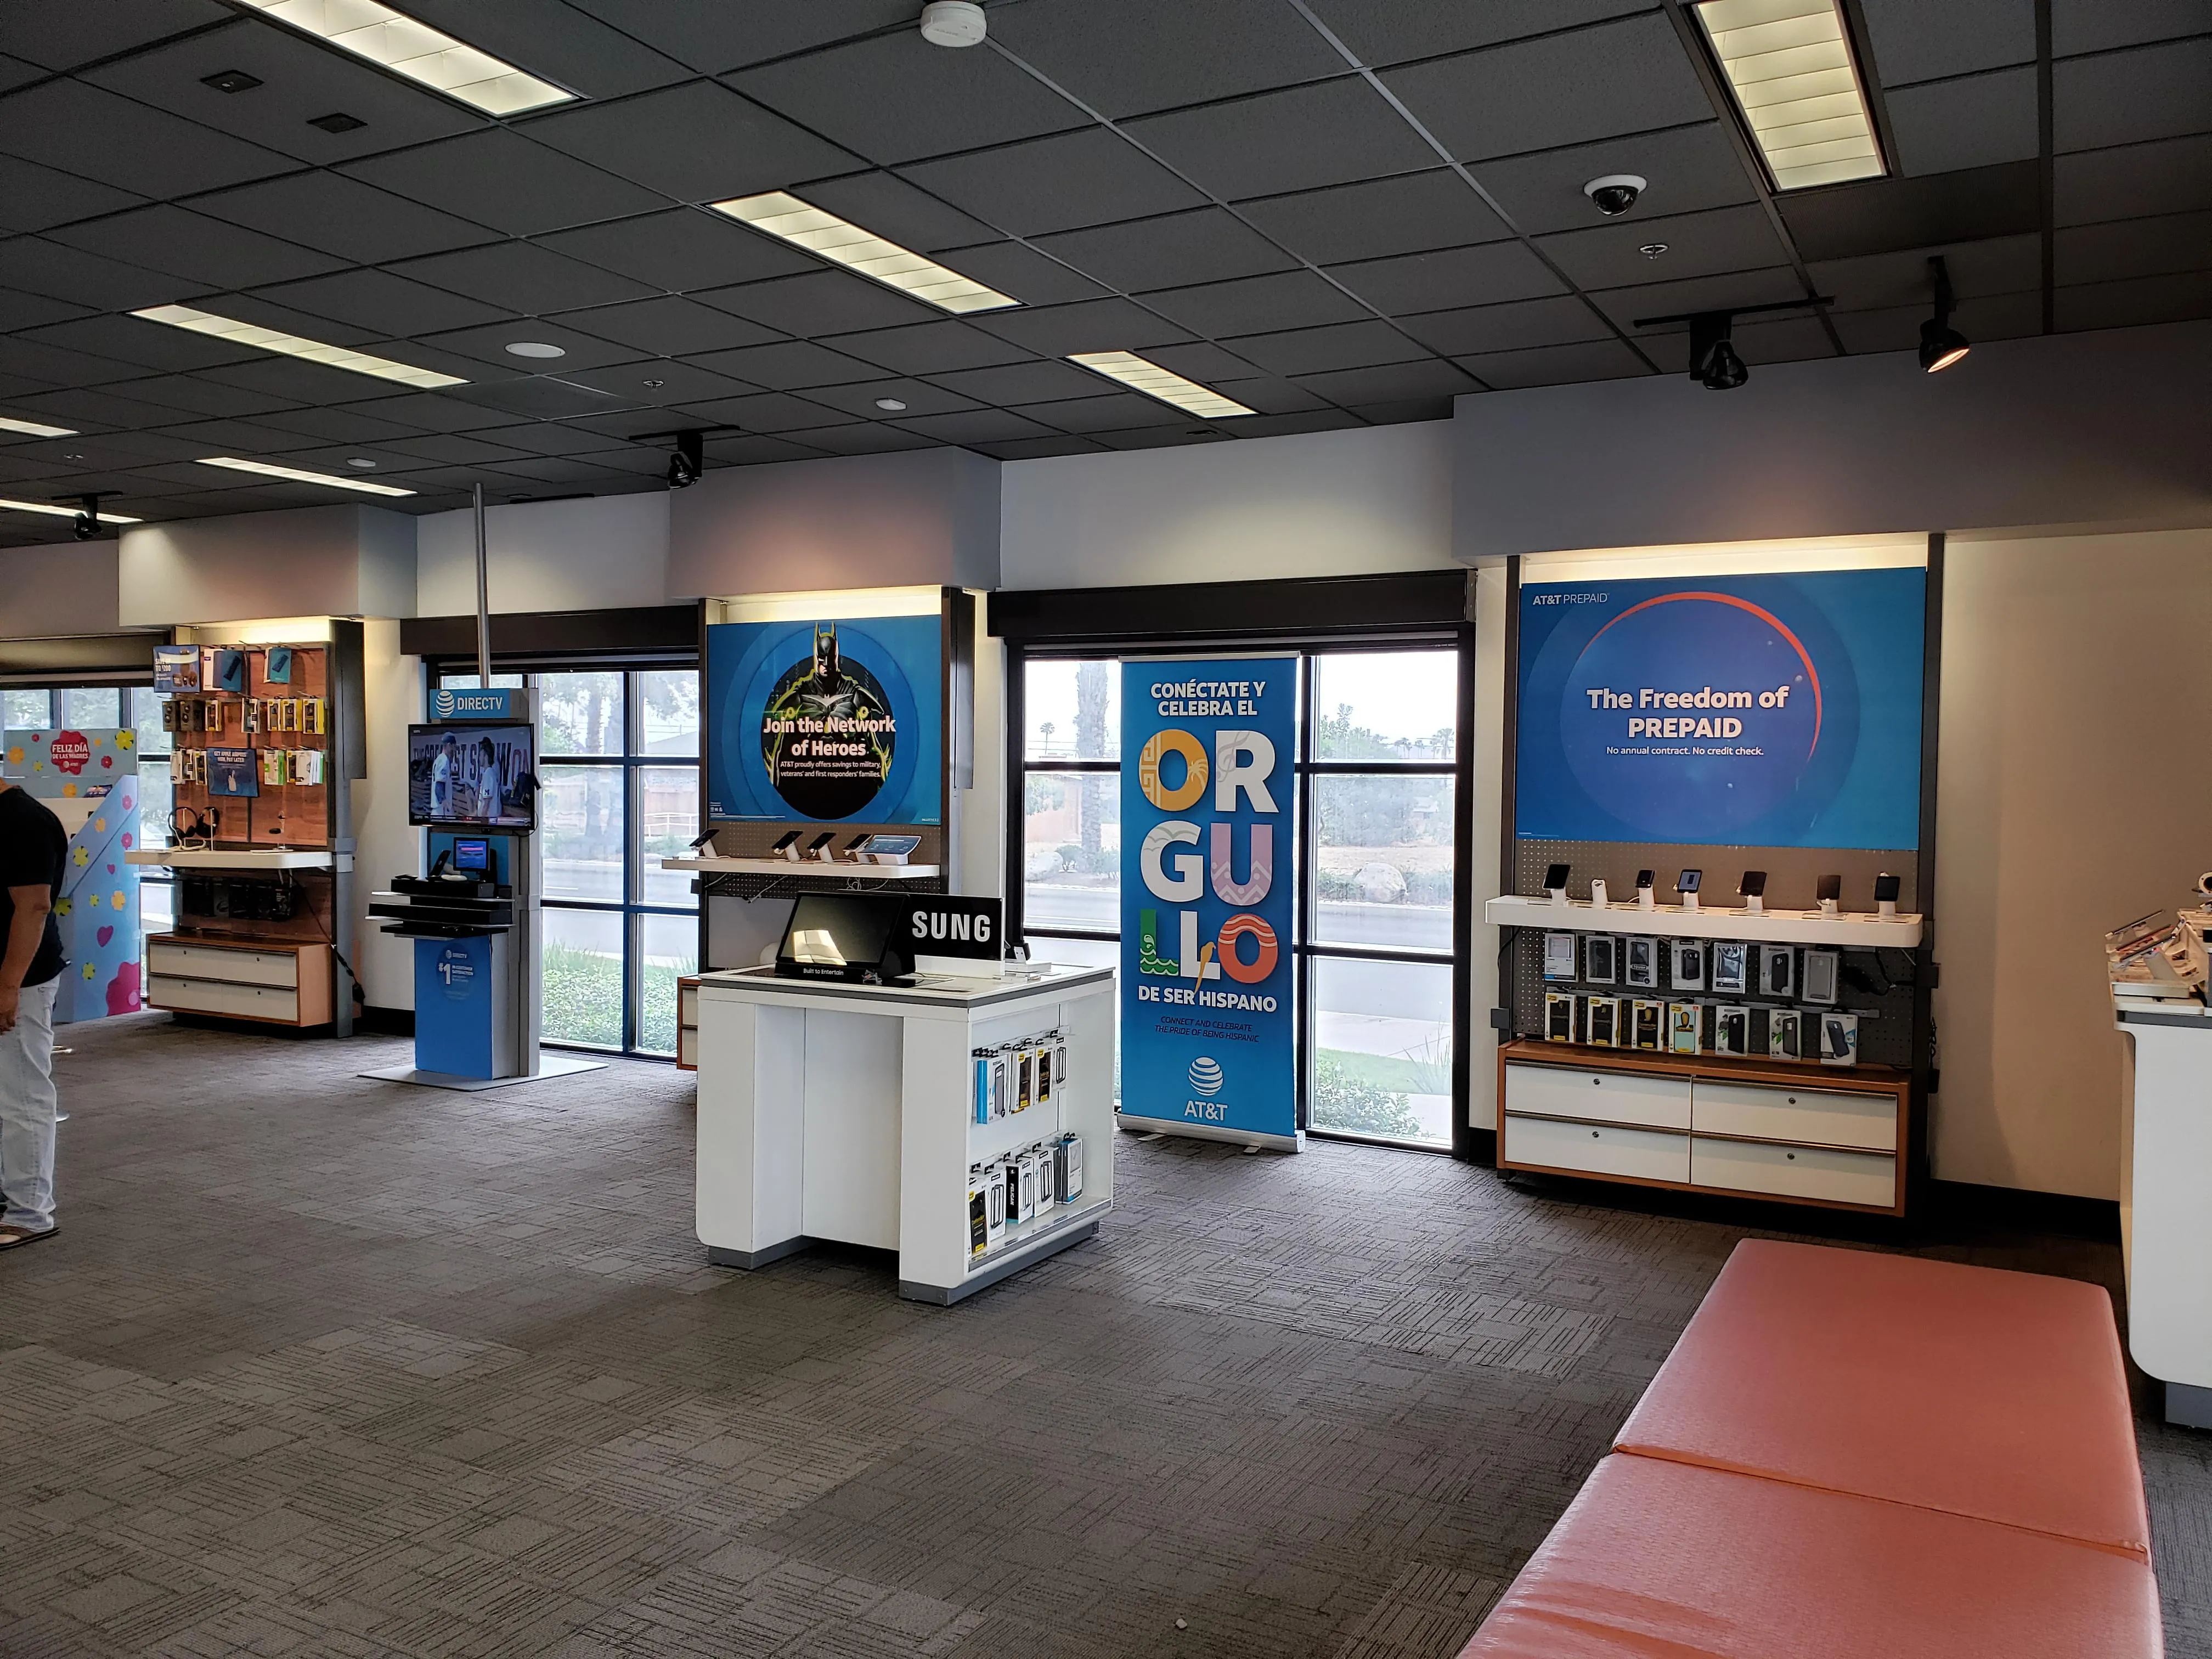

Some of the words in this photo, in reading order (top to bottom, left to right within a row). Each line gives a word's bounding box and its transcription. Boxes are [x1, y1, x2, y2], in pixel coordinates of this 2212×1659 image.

[1533, 595, 1561, 605] AT&T
[1564, 593, 1608, 604] PREPAID
[1151, 679, 1249, 698] CONÉCTATE
[1253, 681, 1266, 697] Y
[458, 697, 503, 710] DIRECTV
[1587, 688, 1633, 709] The
[1639, 687, 1752, 709] Freedom
[1758, 686, 1790, 708] of
[1158, 700, 1233, 716] CELEBRA
[1238, 699, 1257, 715] EL
[763, 716, 794, 733] Join
[797, 716, 823, 733] the
[827, 715, 896, 733] Network
[1628, 718, 1742, 738] PREPAID
[52, 744, 73, 753] FELIZ
[74, 742, 88, 753] DÍA
[791, 740, 809, 756] of
[1606, 747, 1618, 755] No
[1621, 746, 1649, 755] annual
[1651, 747, 1690, 755] contract.
[1707, 747, 1733, 755] credit
[1735, 747, 1764, 755] check.
[912, 911, 990, 942] SUNG
[1138, 985, 1160, 1002] DE
[1164, 988, 1195, 1005] SER
[1199, 991, 1277, 1012] HISPANO
[1161, 1016, 1194, 1025] CONNECT
[1212, 1021, 1253, 1032] CELEBRATE
[1155, 1025, 1167, 1033] THE
[1169, 1027, 1189, 1035] PRIDE
[1203, 1030, 1224, 1039] BEING
[1226, 1034, 1260, 1042] HISPANIC
[1184, 1101, 1228, 1121] AT&T
